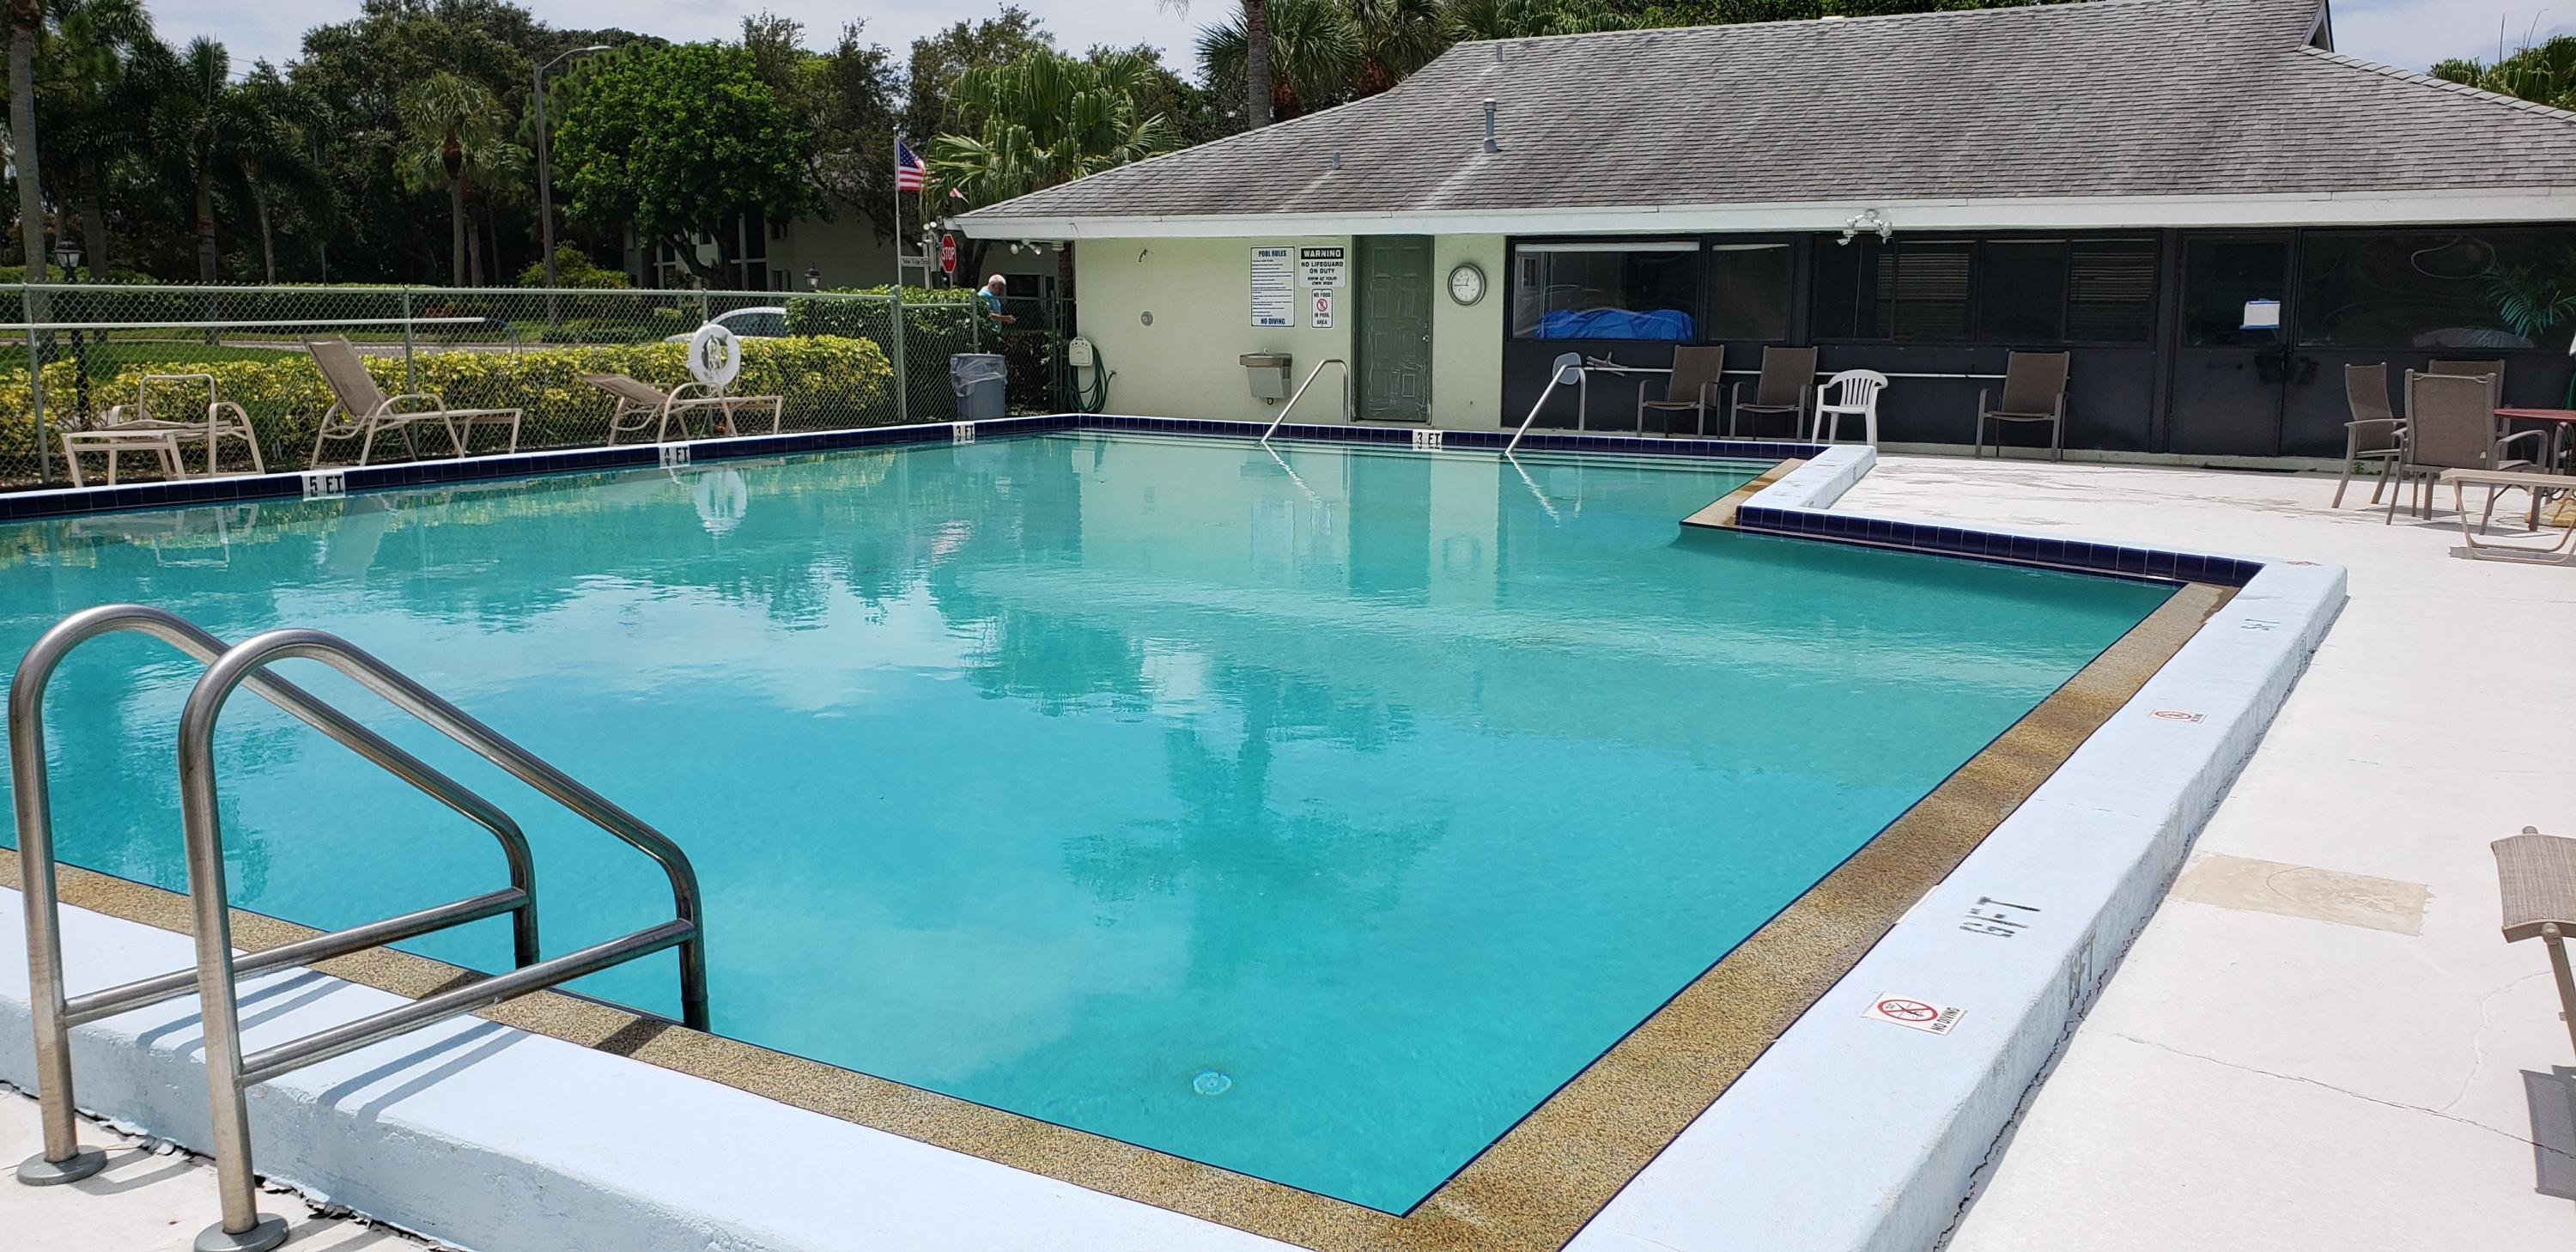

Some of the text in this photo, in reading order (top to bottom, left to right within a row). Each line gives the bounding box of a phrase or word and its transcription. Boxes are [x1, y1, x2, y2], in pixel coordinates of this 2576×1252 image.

[941, 246, 955, 261] STOP
[1303, 249, 1341, 258] WARNING
[956, 425, 974, 442] 3 FT
[1417, 431, 1441, 449] 3 FT
[676, 447, 689, 464] FT
[309, 475, 343, 496] 5 FT
[1930, 1006, 1961, 1032] NO DIVING
